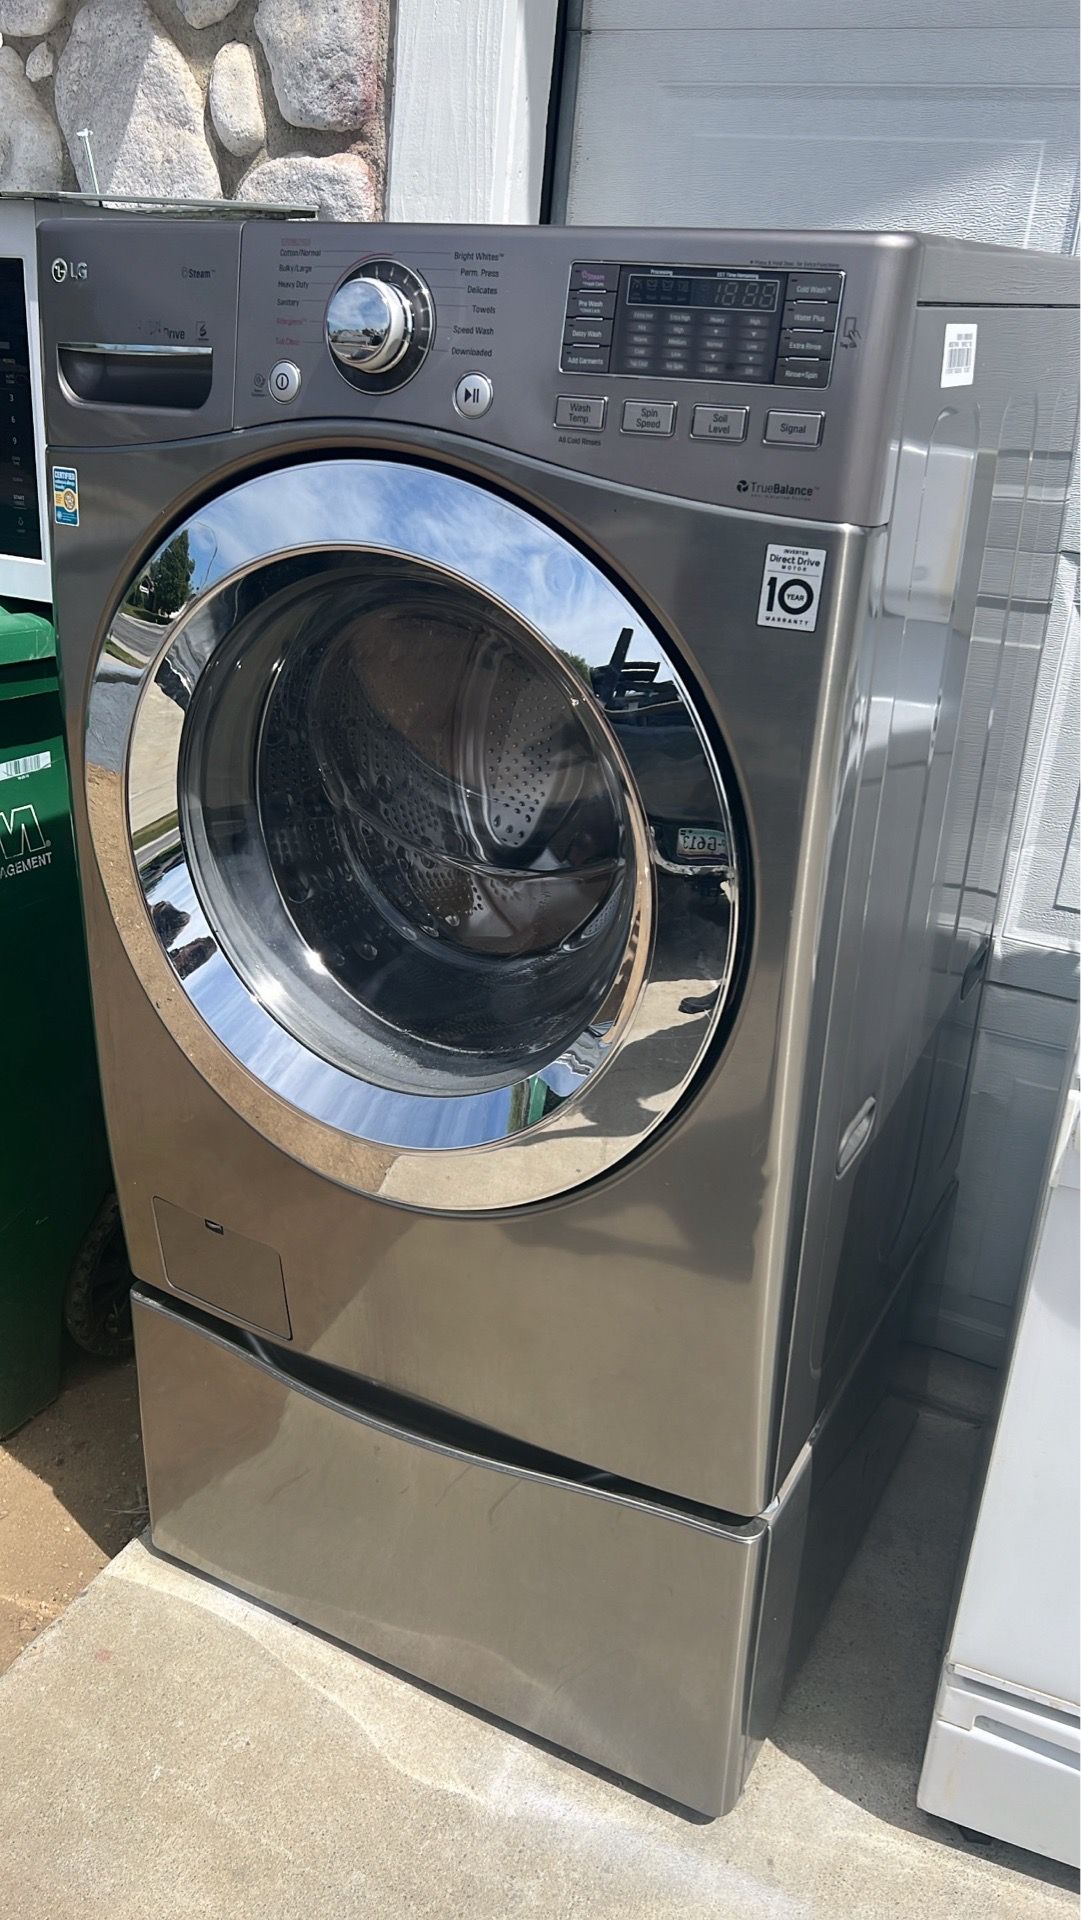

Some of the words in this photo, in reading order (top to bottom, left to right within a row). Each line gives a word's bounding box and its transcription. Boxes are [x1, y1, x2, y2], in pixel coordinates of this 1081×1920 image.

[280, 249, 321, 257] Cotton/Normal
[454, 252, 474, 261] Bright
[70, 261, 87, 280] LG
[279, 264, 312, 273] Bulky/Large
[481, 269, 499, 277] Press
[278, 281, 295, 289] Heavy
[296, 281, 309, 289] Duty
[467, 285, 498, 294] Delicates
[588, 300, 603, 308] Wash
[472, 305, 496, 314] Towels
[453, 325, 474, 335] Speed
[475, 327, 494, 335] Wash
[587, 330, 602, 338] Wash
[451, 347, 492, 357] Downloaded
[570, 403, 591, 413] Wash
[641, 407, 658, 418] Spin
[712, 413, 728, 424] Soil
[636, 418, 661, 430] Speed
[708, 424, 730, 434] Level
[780, 423, 806, 434] Signal
[567, 437, 581, 446] Cold
[581, 438, 602, 447] Rinses
[770, 554, 795, 564] Direct
[797, 557, 820, 567] Drive
[766, 576, 814, 615] 10
[765, 616, 809, 625] WARRANTY
